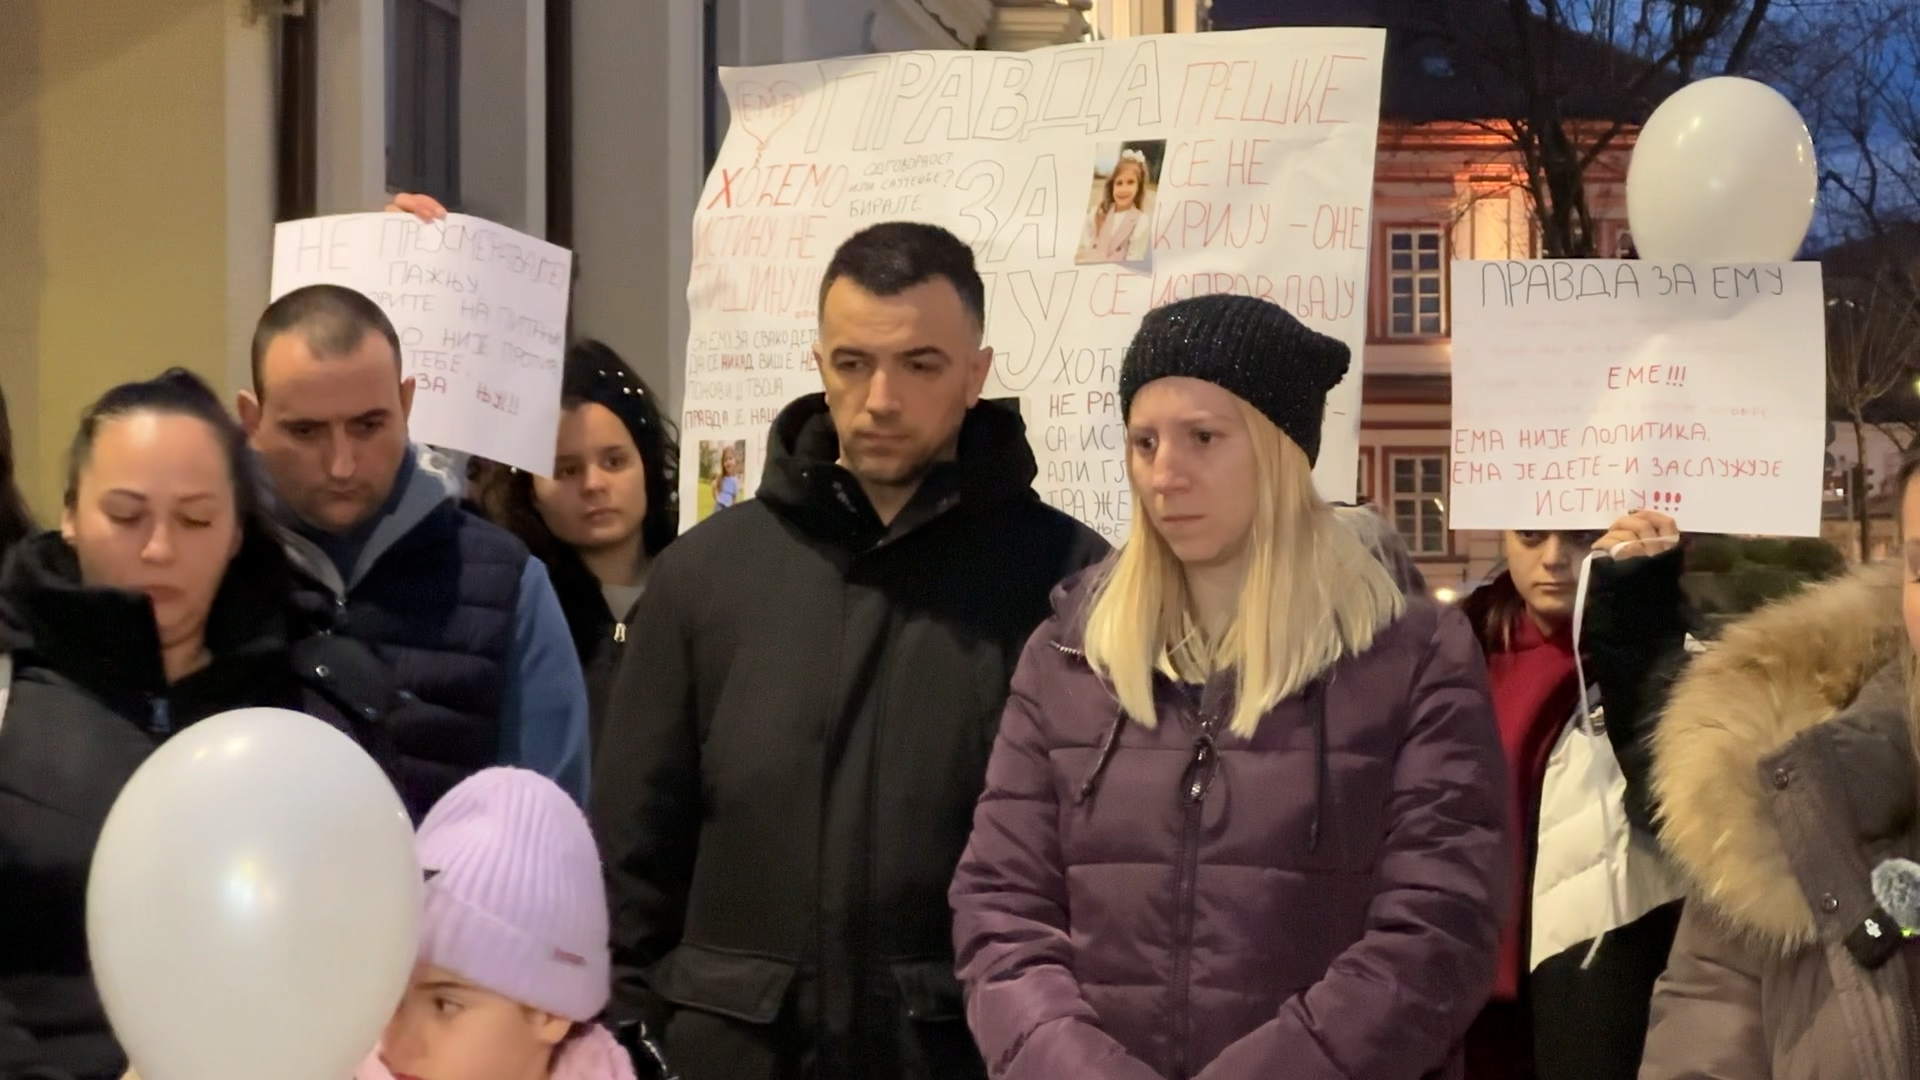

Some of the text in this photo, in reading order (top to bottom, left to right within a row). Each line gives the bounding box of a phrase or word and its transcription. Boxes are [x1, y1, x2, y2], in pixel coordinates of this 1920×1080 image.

[804, 40, 1161, 153] ПРАВДА
[1174, 55, 1367, 127] ГРЕШКЕ
[740, 93, 796, 121] ЕМА
[1169, 138, 1271, 188] СЕ НЕ
[706, 163, 849, 210] ХОЋЕМО
[955, 154, 1059, 263] ЗА
[785, 214, 828, 260] НЕ
[1153, 200, 1271, 249] КРИЈУ
[297, 216, 363, 273] НЕ
[388, 260, 479, 294] ПАЖЊУ
[1481, 261, 1784, 308] ПРАВДА ЗА ЕМУ
[1089, 272, 1138, 318] СЕ
[460, 298, 490, 322] НА
[753, 329, 789, 349] СВАКО
[721, 352, 754, 372] НИКАД
[759, 352, 795, 370] ВИШЕ
[416, 371, 448, 394] ЗА
[746, 377, 784, 398] ТВОЈА
[1607, 363, 1687, 390] ЕМЕ!!!
[1049, 392, 1078, 418] НЕ
[684, 409, 729, 431] ПРАВДА
[1044, 425, 1068, 453] СА
[1454, 428, 1505, 454] ЕМА
[1518, 428, 1571, 449] НИЈЕ
[1046, 459, 1091, 484] АЛИ
[1452, 460, 1502, 484] ЕМА
[1651, 456, 1783, 478] ЗАСЛУЖУЈЕ
